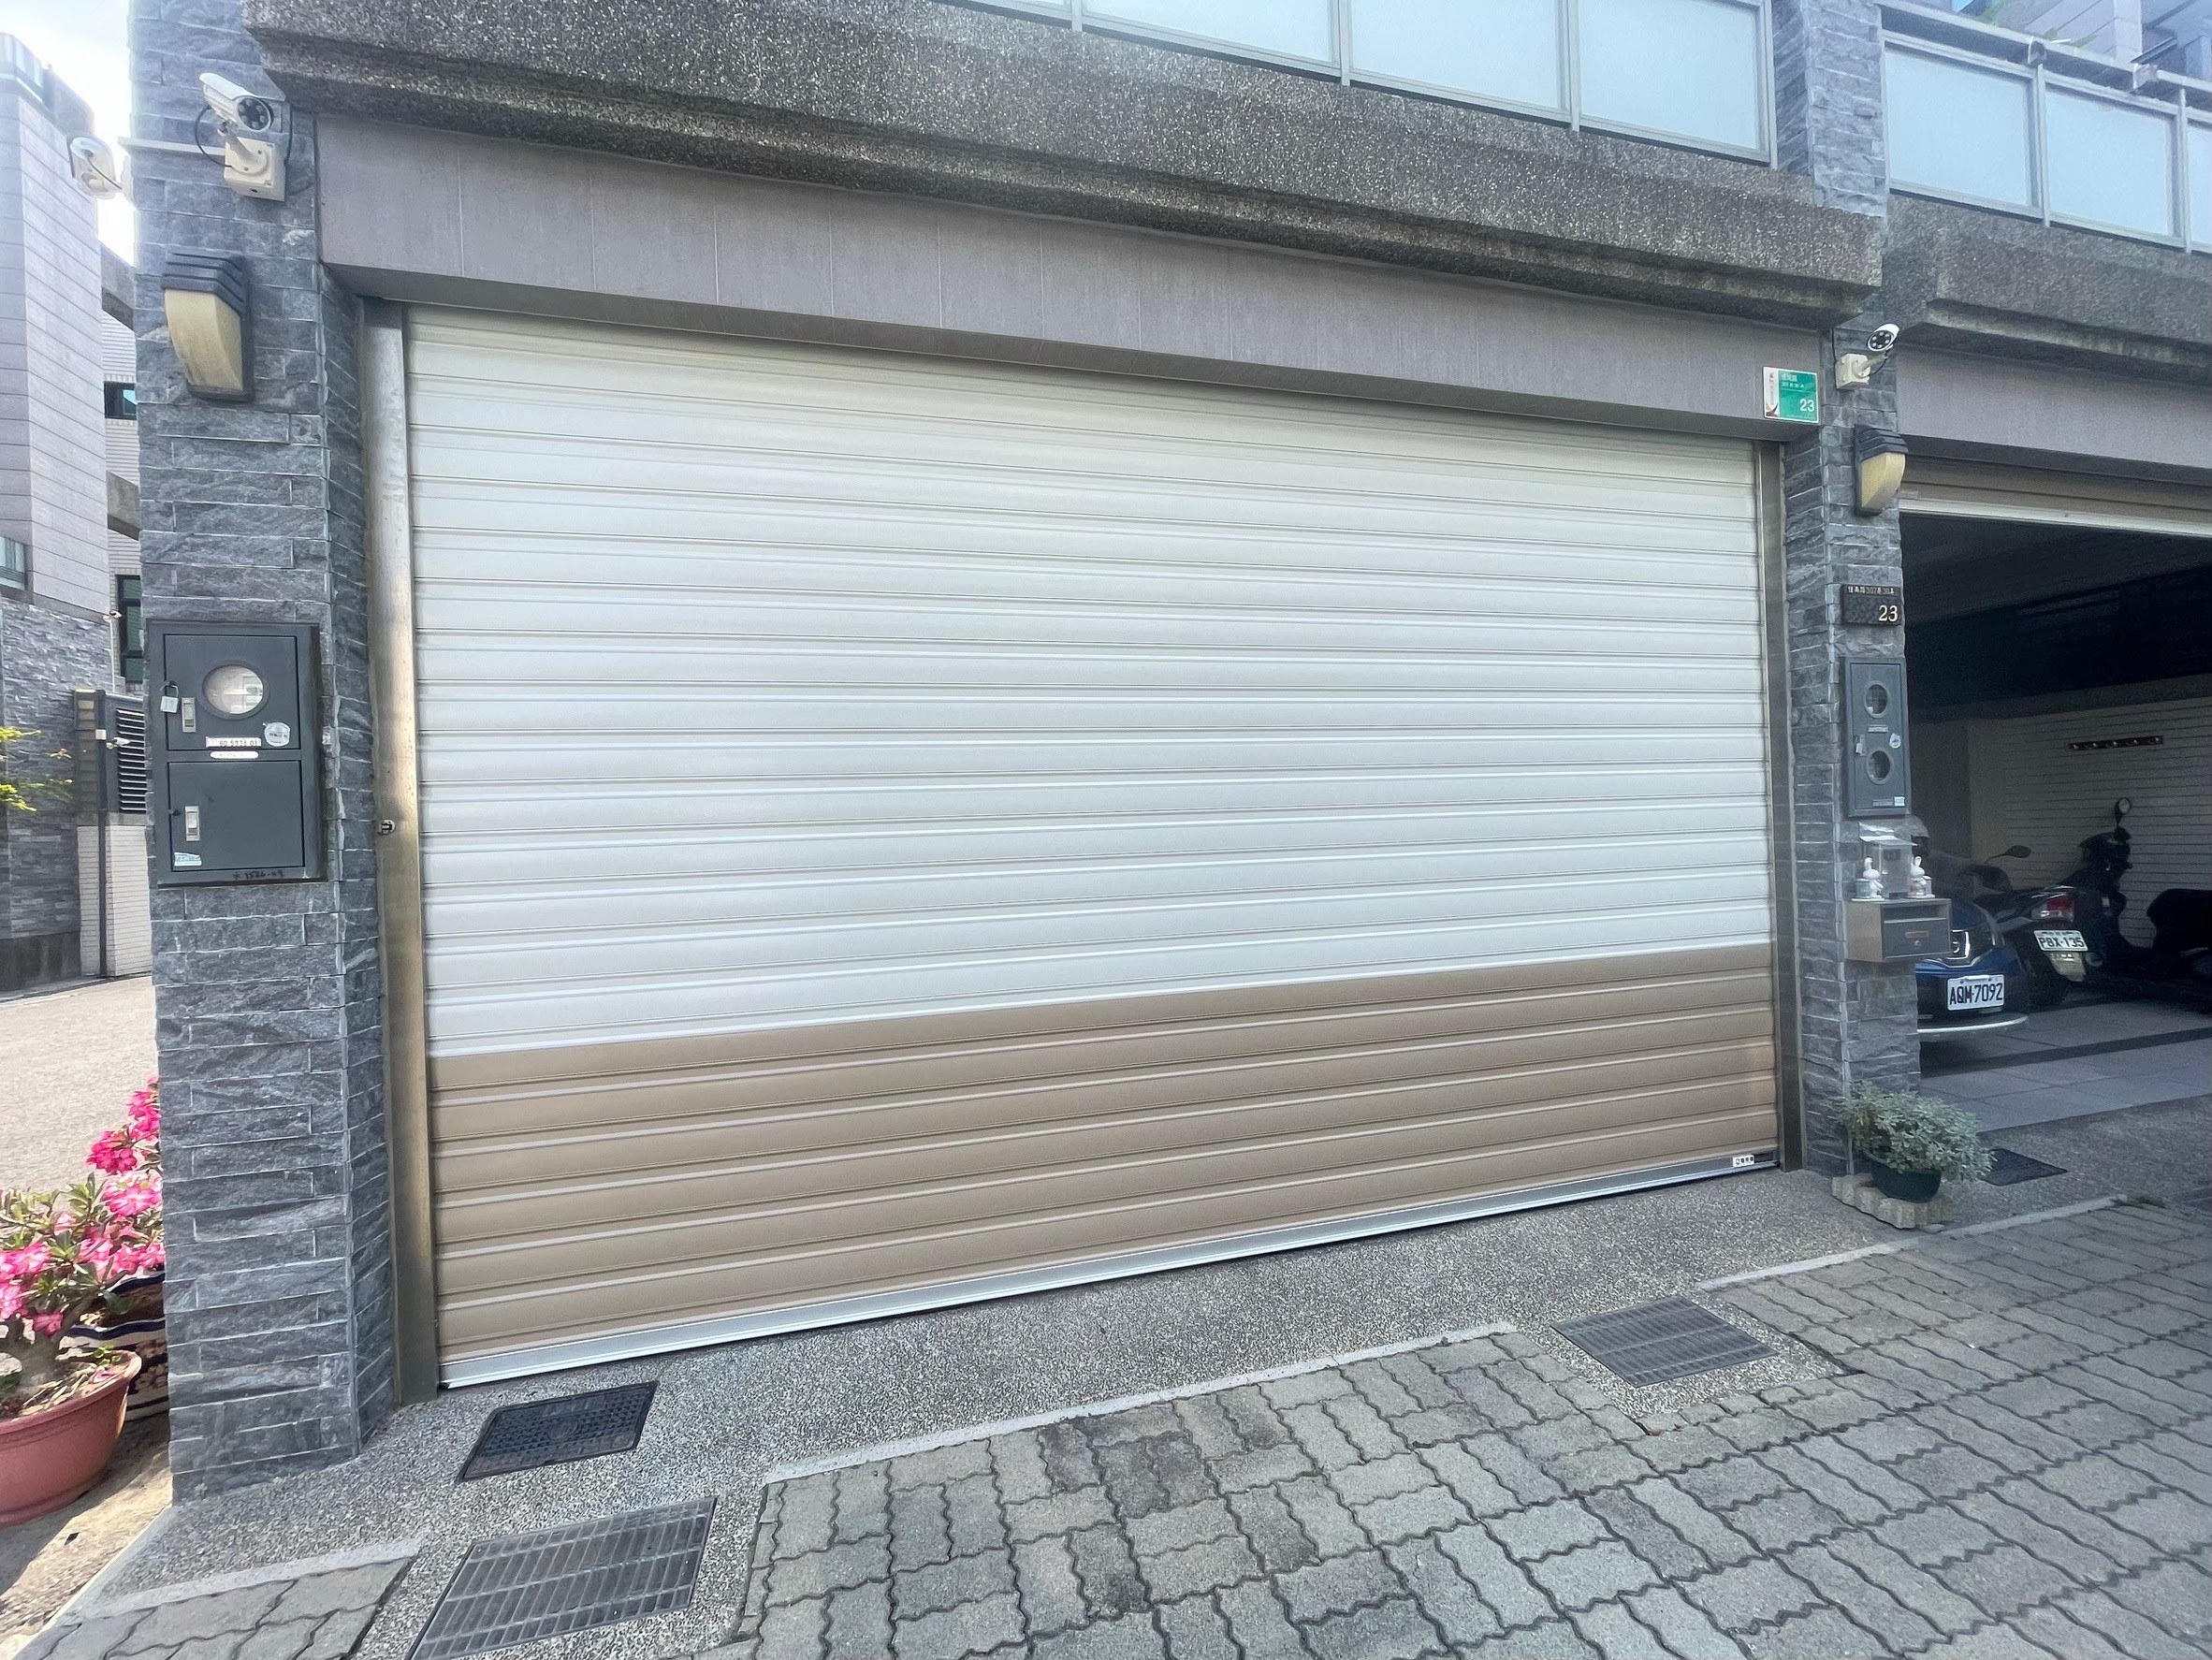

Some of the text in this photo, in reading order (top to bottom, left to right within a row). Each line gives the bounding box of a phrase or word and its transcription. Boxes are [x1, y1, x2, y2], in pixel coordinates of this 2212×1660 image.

[1799, 398, 1815, 412] 23
[1878, 604, 1899, 622] 23
[2038, 937, 2085, 948] PBX-135
[1949, 983, 2003, 1006] AQM-7092
